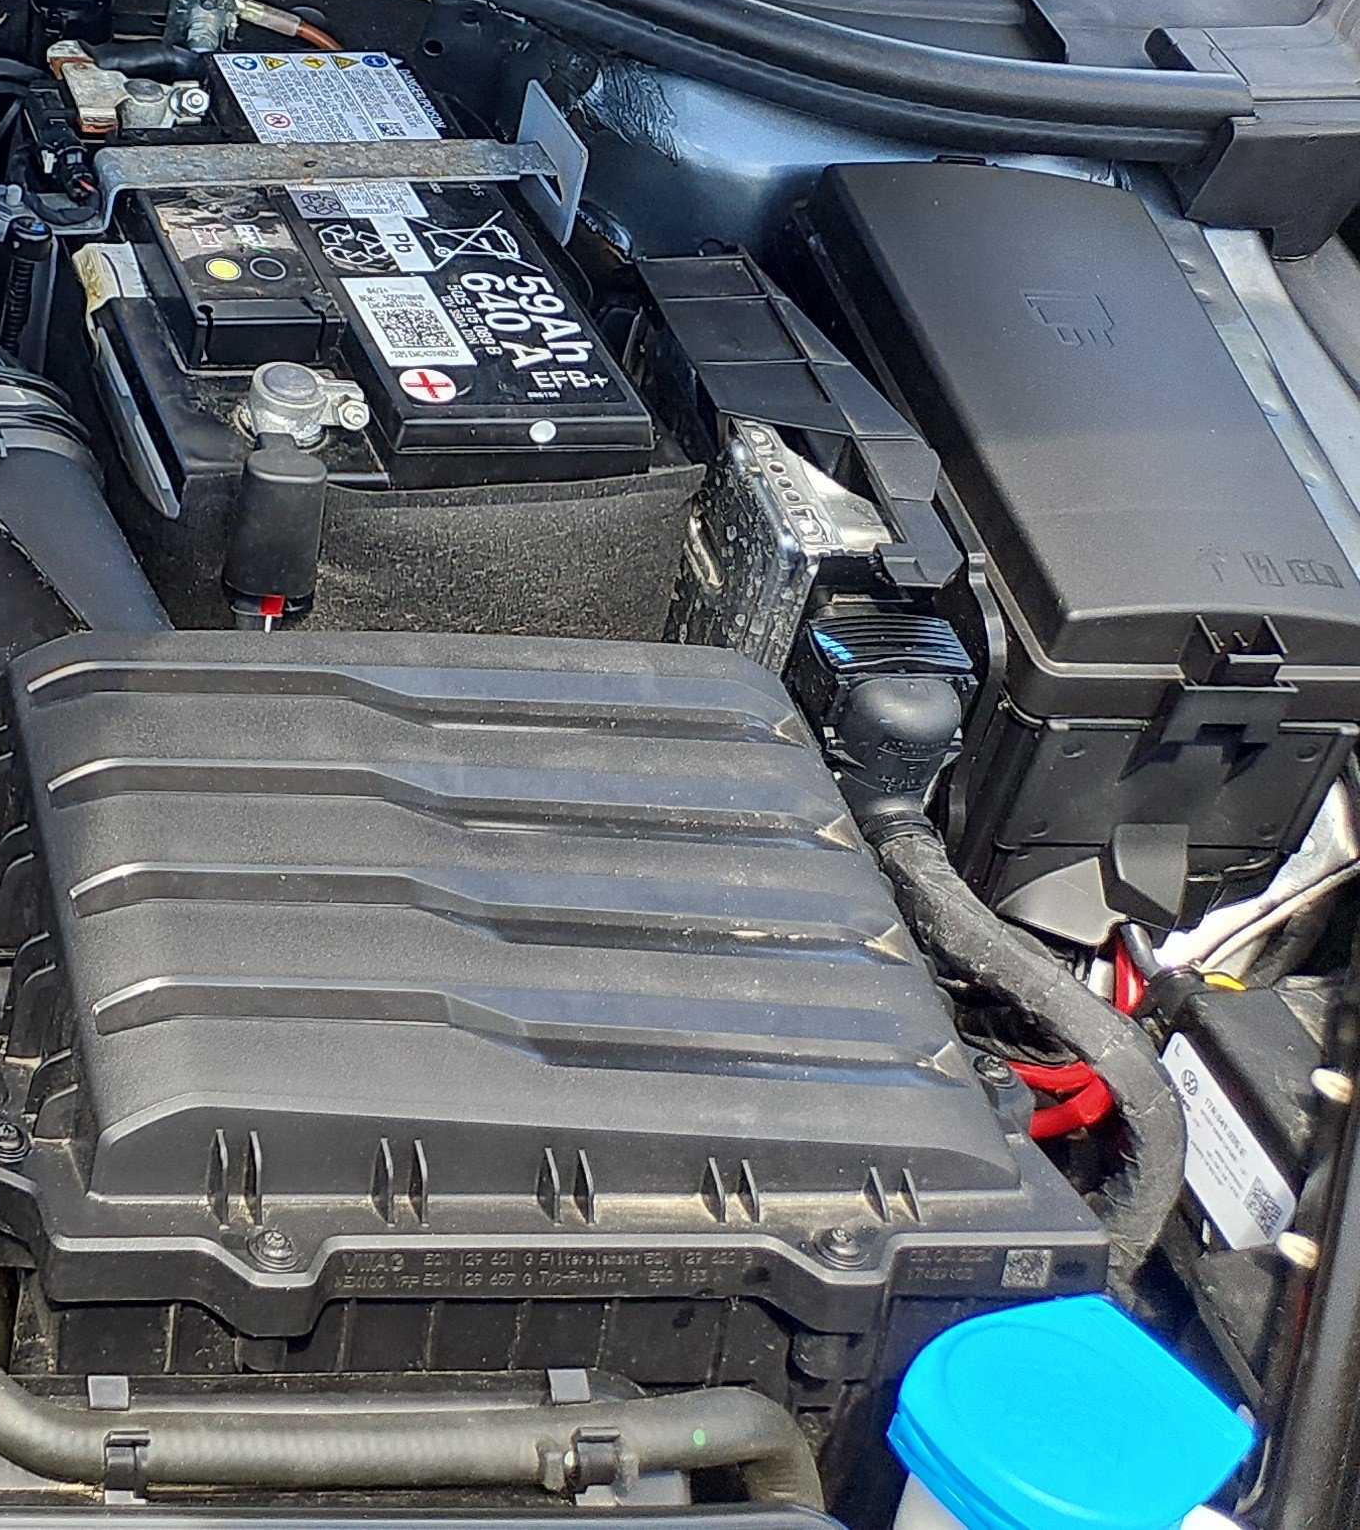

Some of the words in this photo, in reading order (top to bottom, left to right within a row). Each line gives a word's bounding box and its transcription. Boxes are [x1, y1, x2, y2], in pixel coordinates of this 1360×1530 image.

[398, 69, 448, 128] DANGER/POISON
[386, 231, 416, 254] Pb
[460, 272, 532, 333] 640
[499, 340, 554, 371] A
[460, 306, 484, 325] 915
[472, 326, 496, 346] 089
[485, 346, 504, 357] B
[506, 274, 594, 363] 59Ah
[530, 369, 610, 391] EFB+
